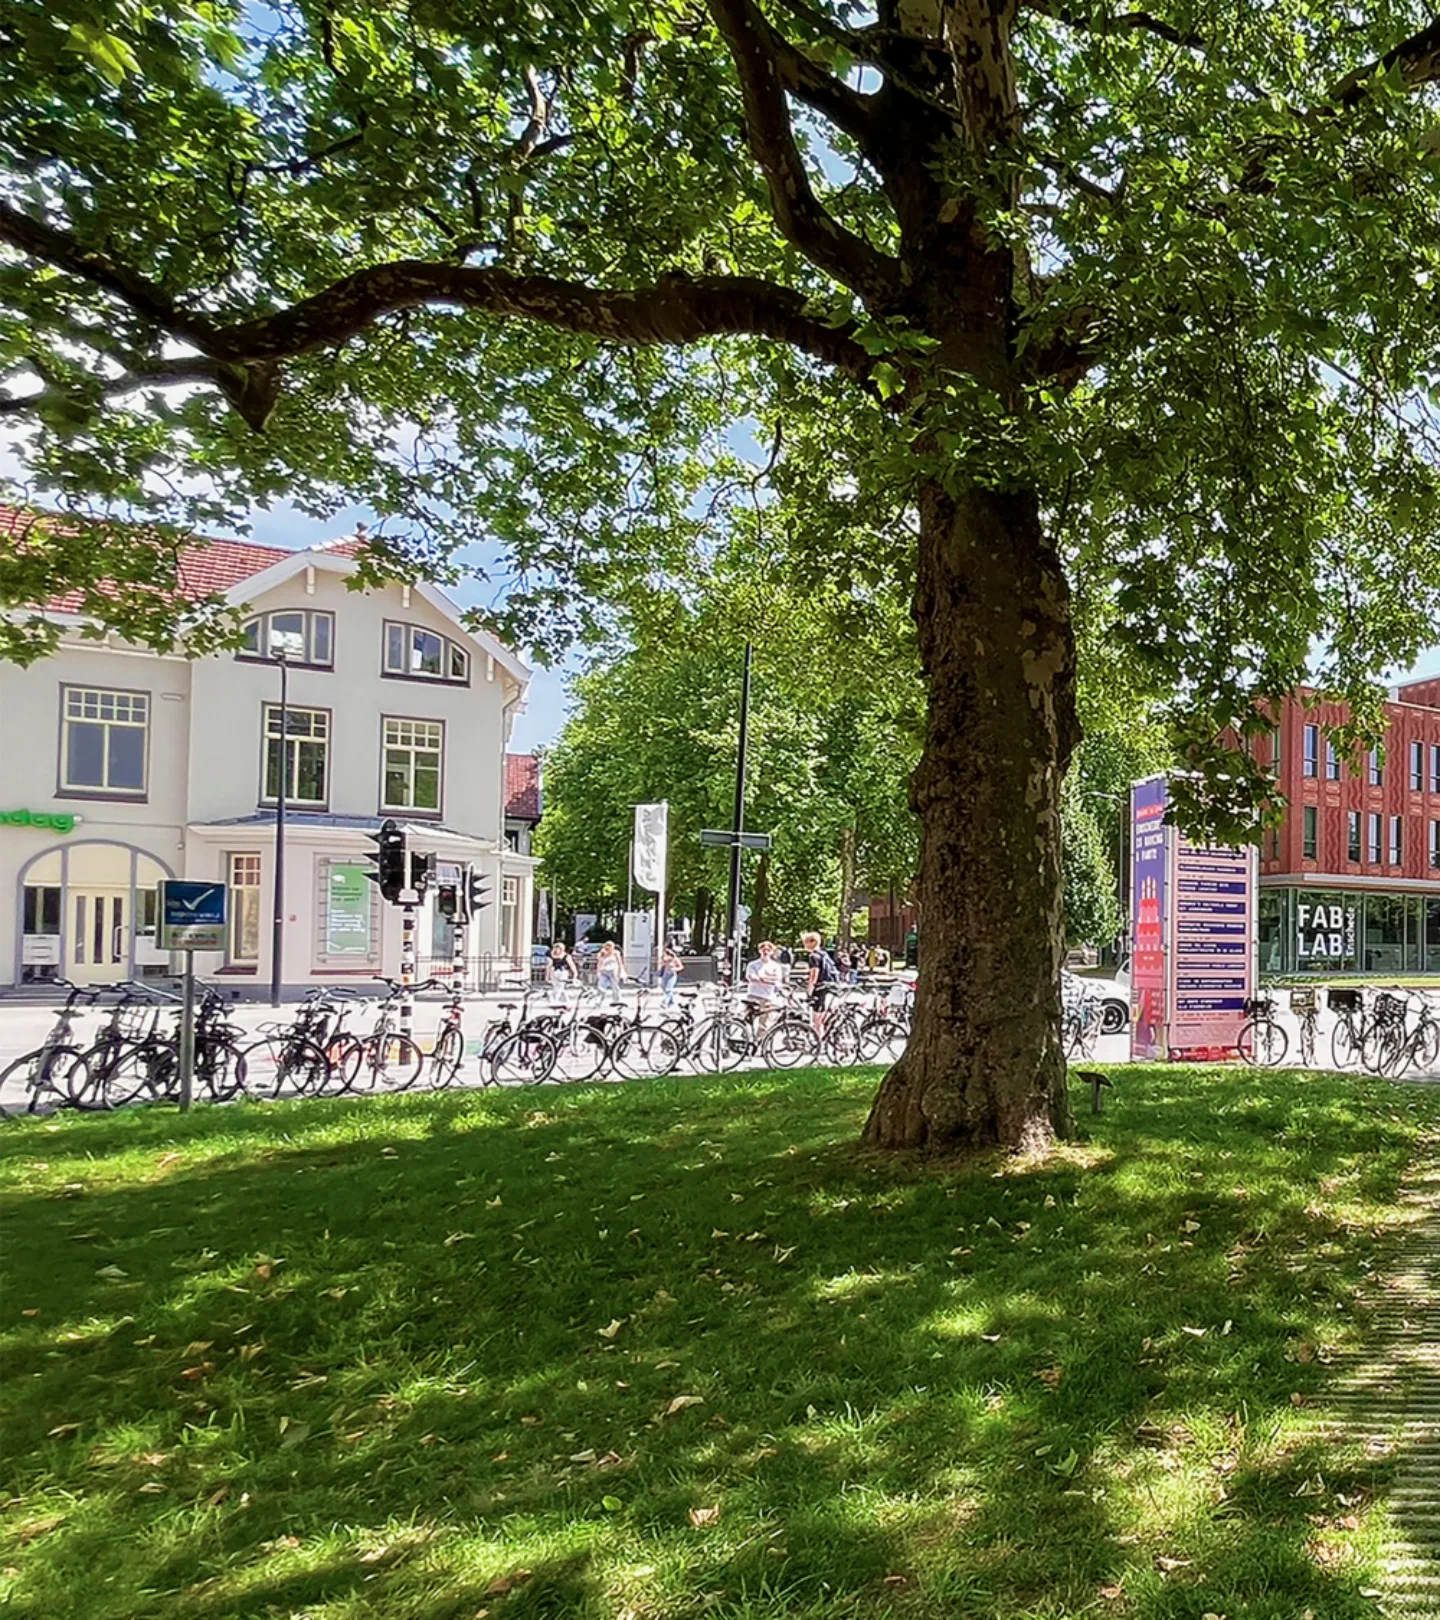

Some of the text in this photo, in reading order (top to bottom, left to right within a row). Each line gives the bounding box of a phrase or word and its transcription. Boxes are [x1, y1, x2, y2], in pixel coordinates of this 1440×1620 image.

[1297, 904, 1343, 928] FAB
[1345, 906, 1355, 957] Enschede
[1297, 932, 1343, 956] LAB
